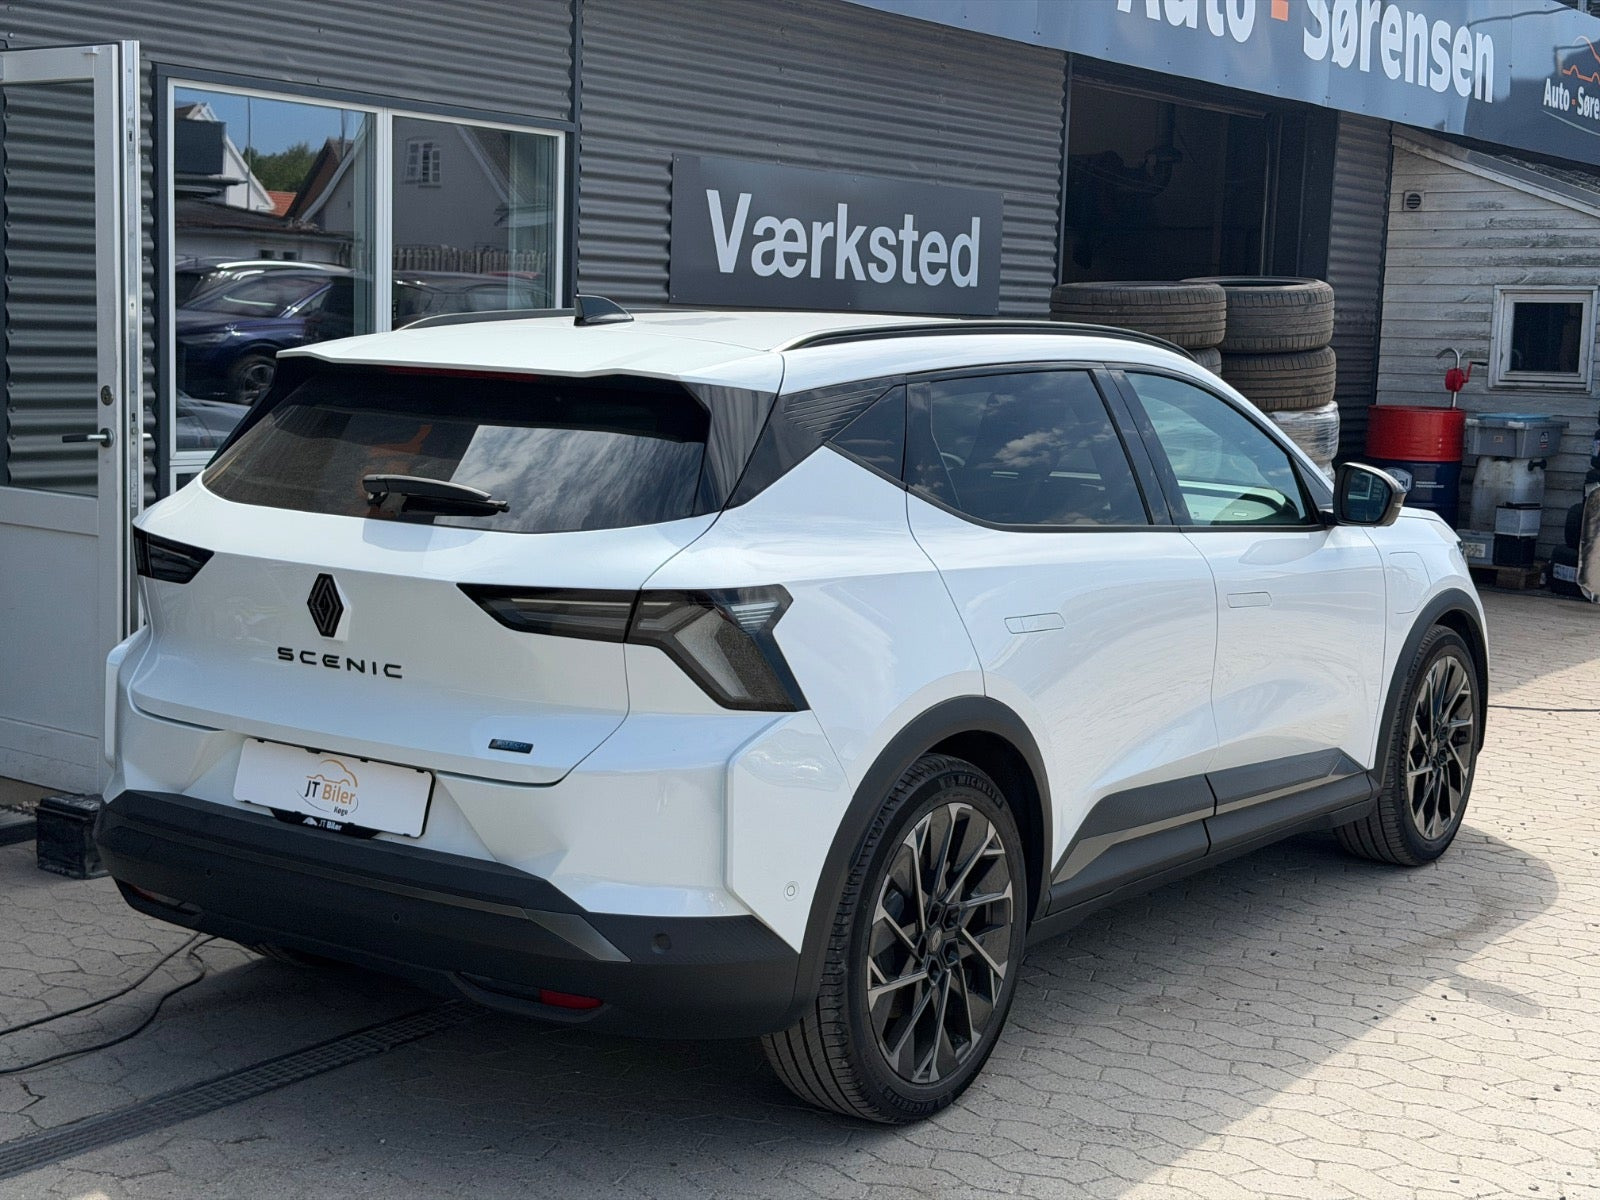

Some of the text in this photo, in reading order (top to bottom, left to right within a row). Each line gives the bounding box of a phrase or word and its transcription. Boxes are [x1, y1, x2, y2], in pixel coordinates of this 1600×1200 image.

[1303, 0, 1495, 104] Sørensen
[1543, 77, 1600, 120] Auto Søre
[706, 189, 981, 288] Værksted
[277, 646, 403, 679] SCENIC
[305, 780, 356, 805] JT Biler
[326, 820, 343, 831] Biler
